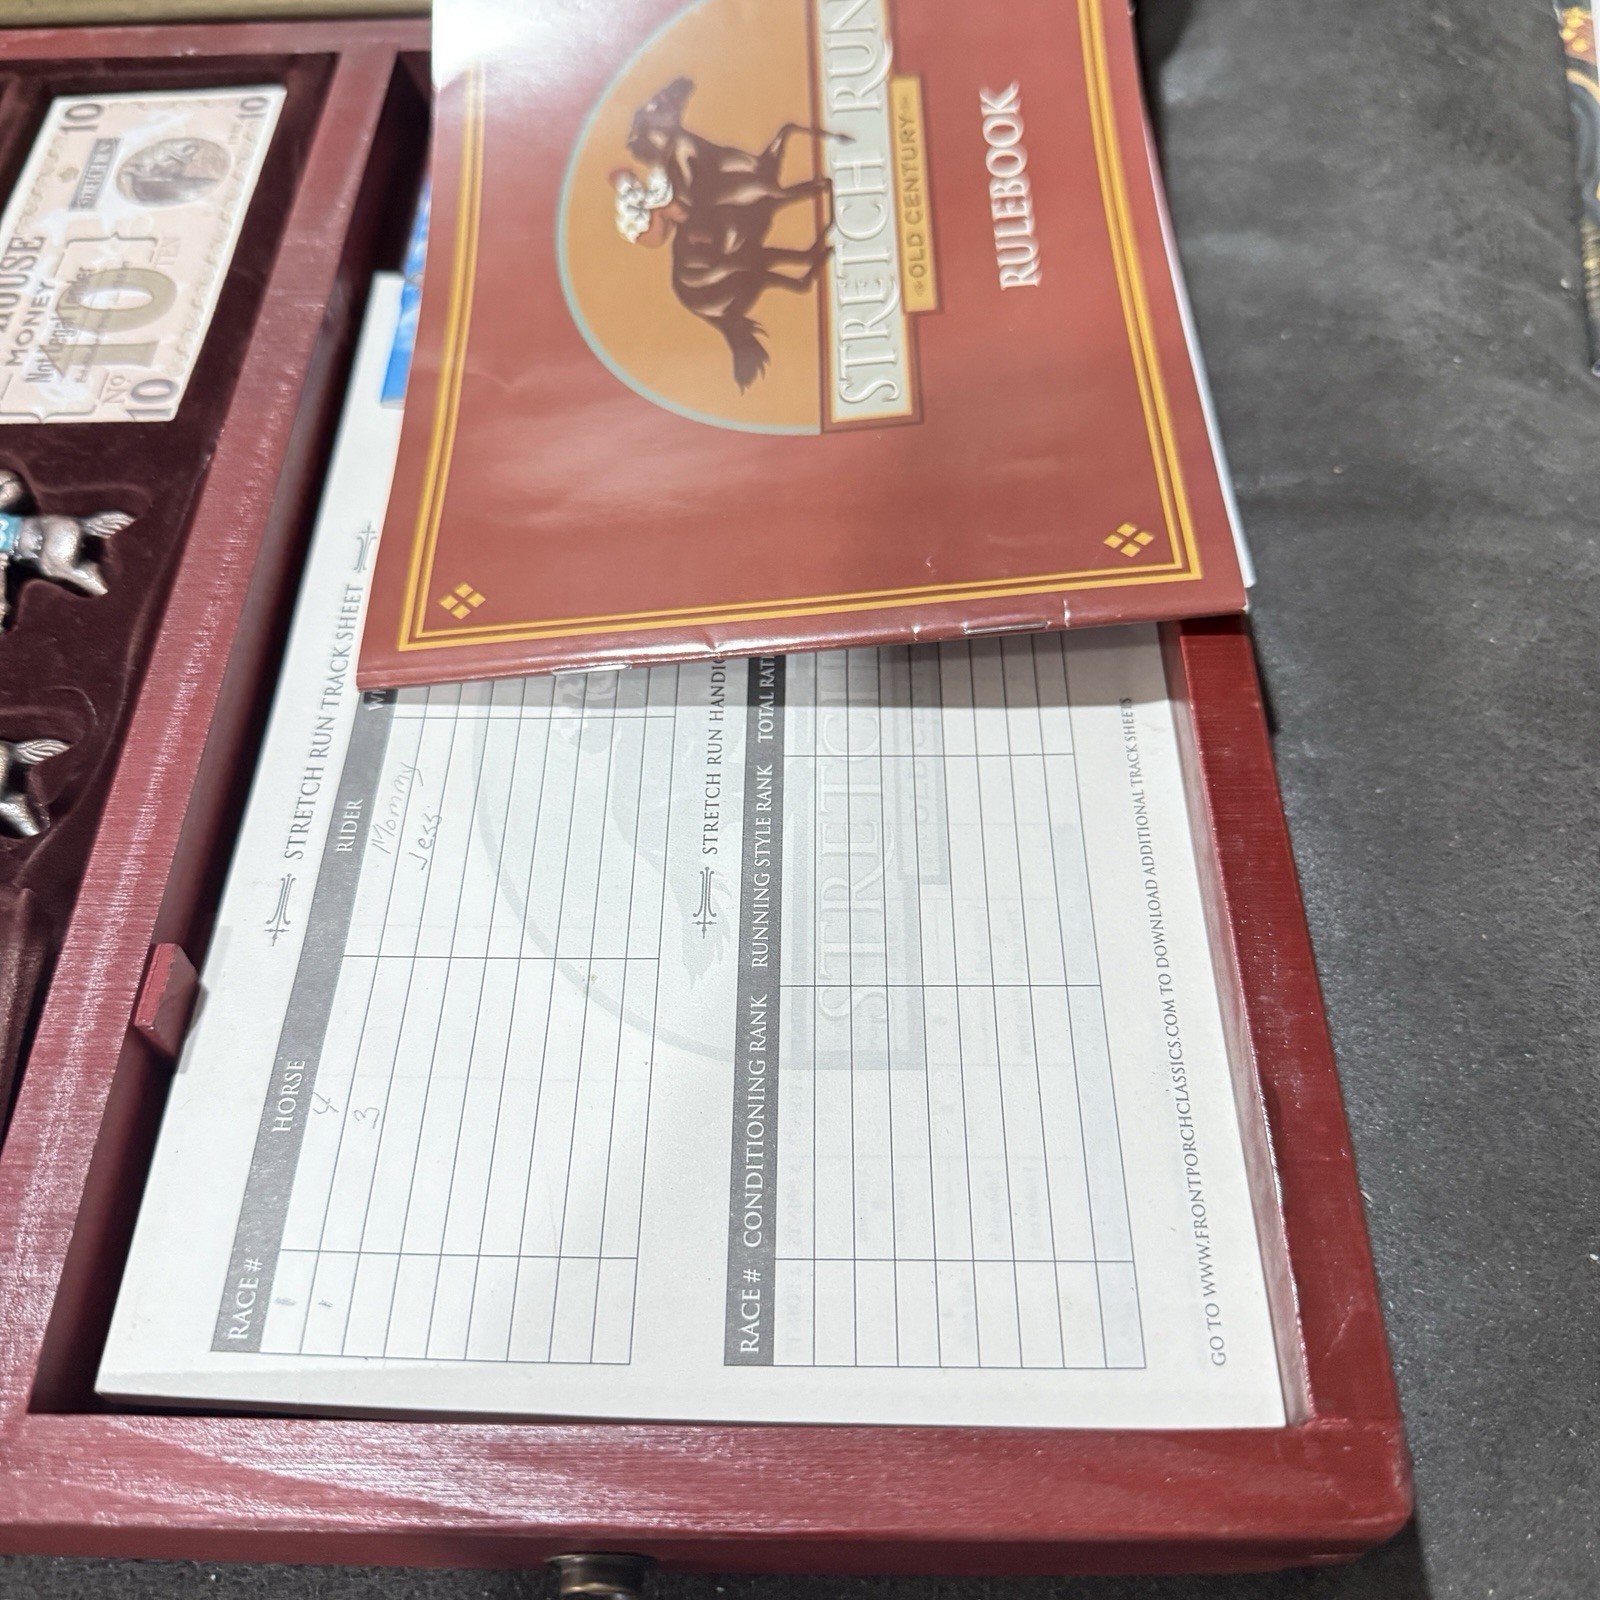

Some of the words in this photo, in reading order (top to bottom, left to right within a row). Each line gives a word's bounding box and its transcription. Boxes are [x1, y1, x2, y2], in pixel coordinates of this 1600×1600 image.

[824, 0, 894, 113] RUN
[59, 103, 103, 134] 10
[236, 96, 268, 119] 10
[898, 115, 924, 225] CENTURY
[979, 79, 1042, 291] RULEBOOK
[834, 157, 901, 404] STRETCH
[908, 231, 928, 279] OLD
[5, 281, 55, 366] MONEY
[39, 266, 178, 377] 10
[124, 378, 180, 421] 10
[336, 584, 364, 643] SHEET
[320, 647, 350, 713] TRACK
[309, 716, 336, 759] RUN
[758, 691, 775, 743] TOTAL
[1119, 696, 1137, 743] SHEETS
[706, 728, 723, 766] RUN
[1125, 744, 1144, 787] TRACK
[284, 766, 325, 860] STRETCH
[701, 771, 722, 855] STRETCH
[756, 764, 773, 812] RANK
[335, 798, 363, 855] RIDER
[754, 816, 772, 867] STYLE
[1129, 788, 1157, 876] ADDITIONAL
[751, 872, 771, 969] RUNNING
[1146, 879, 1170, 968] DOWNLOAD
[1157, 972, 1175, 999] TO
[749, 992, 768, 1051] RANK
[271, 1060, 306, 1133] HORSE
[743, 1058, 766, 1248] CONDITIONING
[1163, 999, 1217, 1296] WWW.FRONTPORCHCLASSICS.COM
[226, 1276, 259, 1341] RACE
[244, 1257, 263, 1272] #
[743, 1267, 762, 1283] #
[739, 1288, 761, 1354] RACE
[1204, 1303, 1221, 1330] TO
[1208, 1335, 1227, 1367] GO
